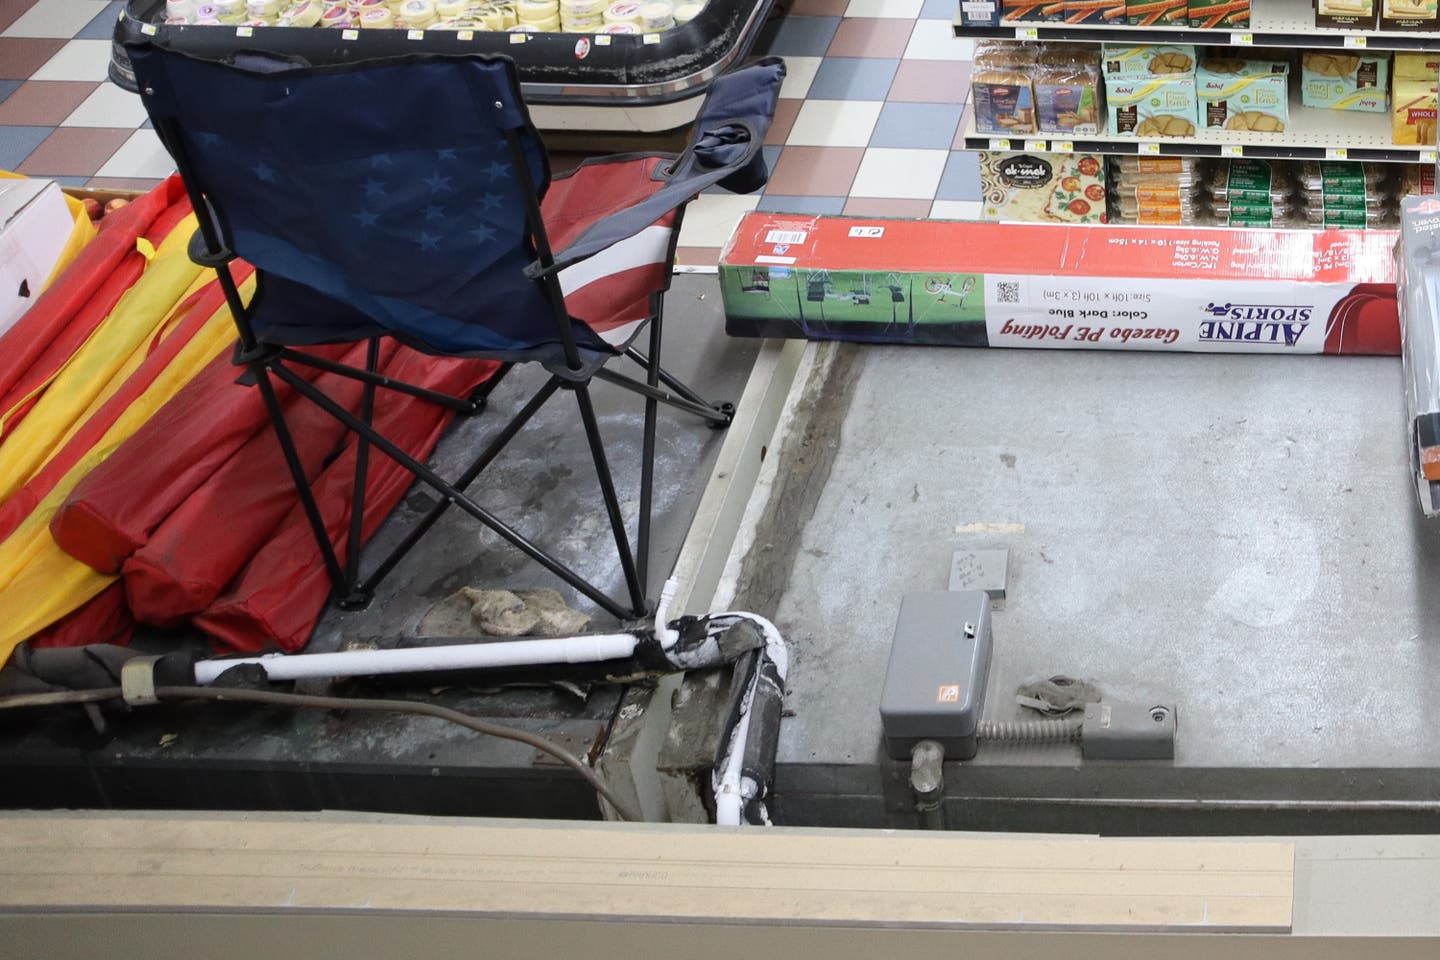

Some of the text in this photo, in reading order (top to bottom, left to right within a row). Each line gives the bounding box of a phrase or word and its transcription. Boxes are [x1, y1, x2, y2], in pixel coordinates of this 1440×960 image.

[1411, 110, 1436, 118] WHOLE
[1192, 239, 1221, 247] Packing
[1172, 260, 1217, 269] 1PC/Carton
[1048, 308, 1148, 320] Color: Dark Blue
[1231, 307, 1313, 322] SPORTS
[1000, 317, 1180, 344] Gazebo PE Folding
[1200, 321, 1309, 347] ALPINE
